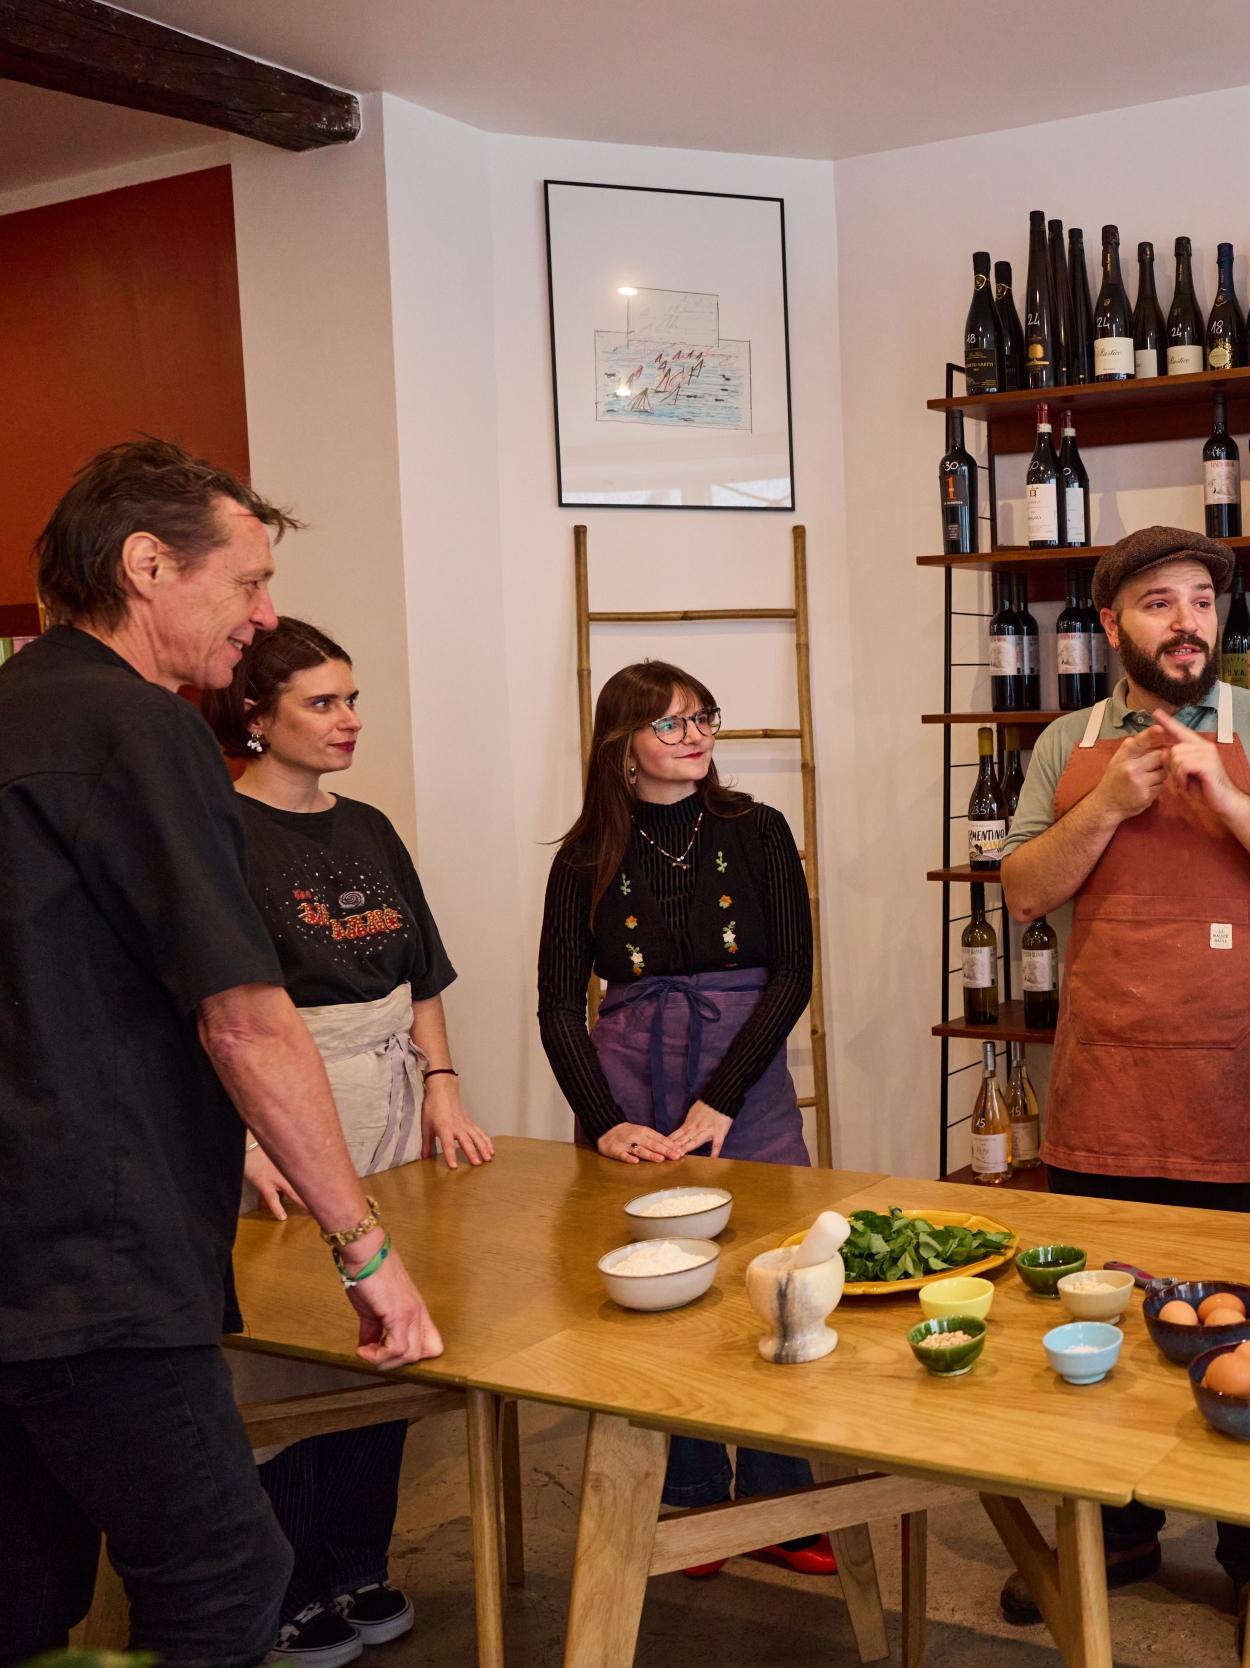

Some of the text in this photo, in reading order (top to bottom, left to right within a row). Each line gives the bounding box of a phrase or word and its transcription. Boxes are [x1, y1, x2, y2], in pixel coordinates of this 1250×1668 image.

[1027, 313, 1040, 326] 24
[1096, 316, 1110, 328] 24
[1210, 319, 1224, 334] 18
[944, 460, 959, 472] 30
[975, 1117, 986, 1129] 15
